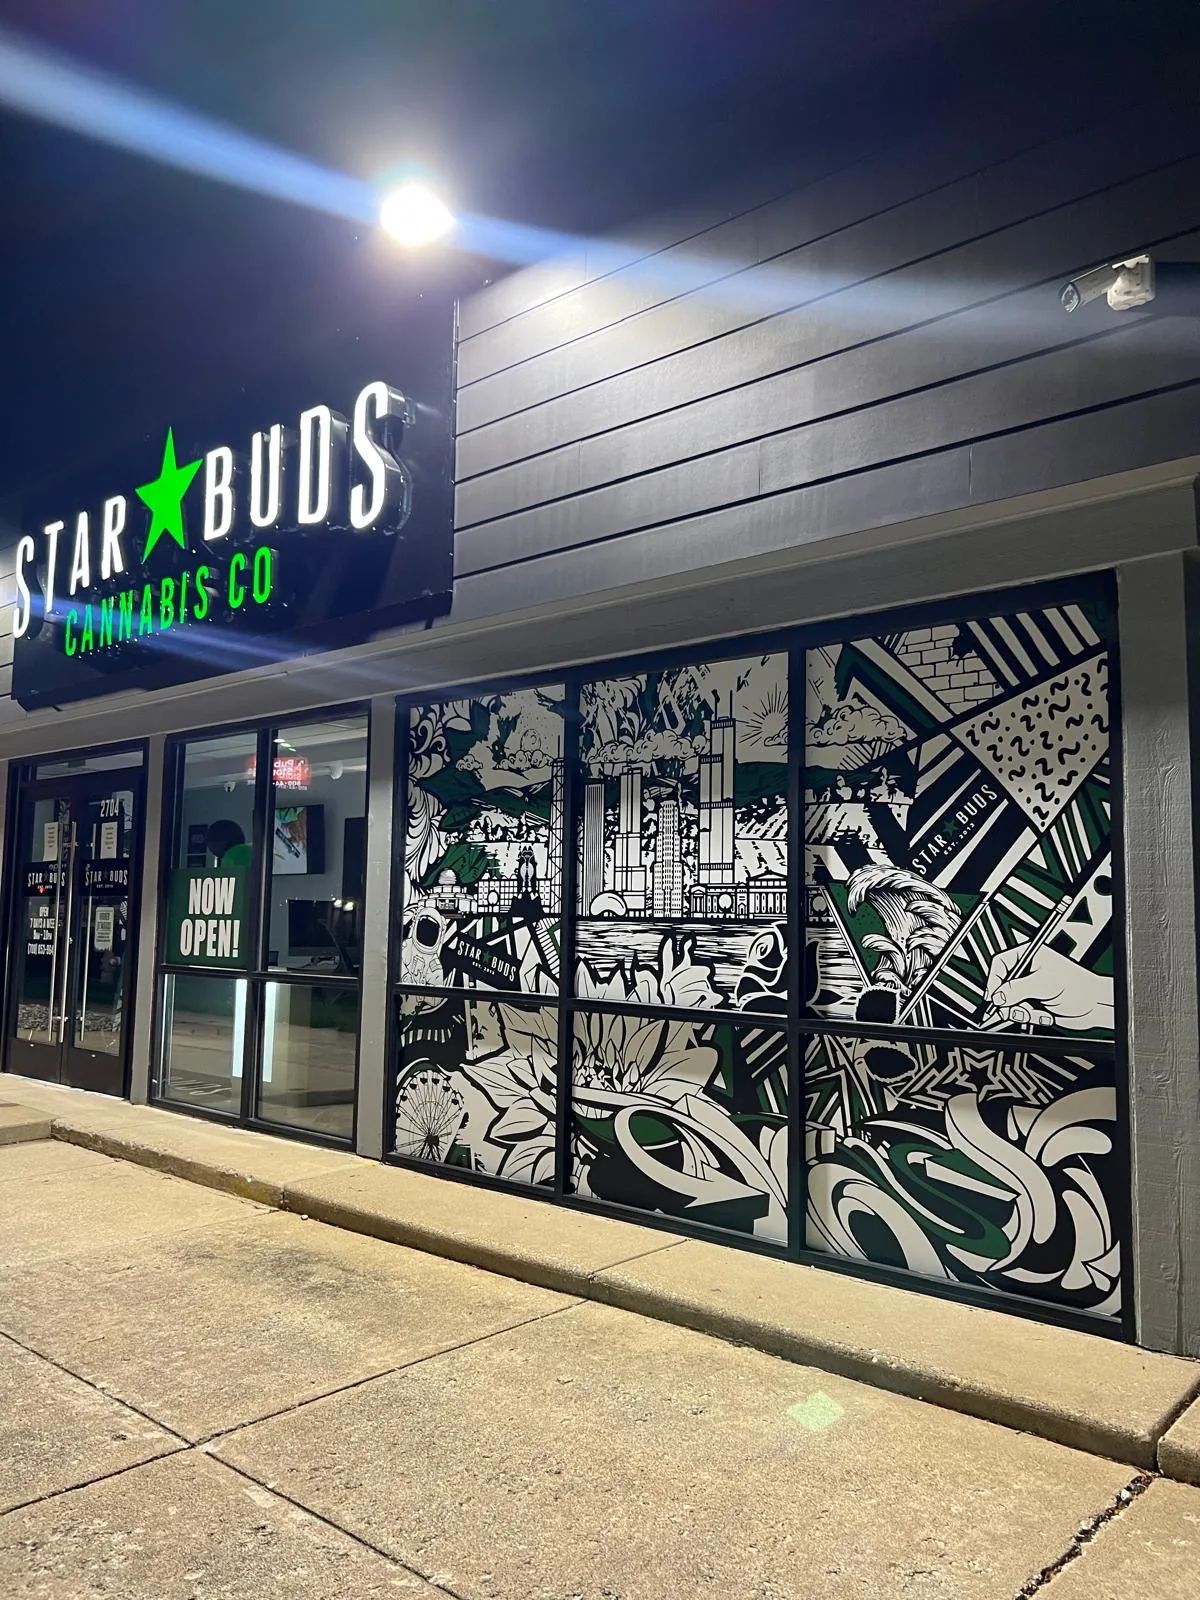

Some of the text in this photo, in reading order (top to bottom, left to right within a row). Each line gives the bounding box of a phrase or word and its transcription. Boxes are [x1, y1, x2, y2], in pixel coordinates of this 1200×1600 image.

[13, 381, 389, 638] STAR BUDS
[65, 546, 273, 656] CANNABIS CO
[100, 799, 119, 817] 2704
[912, 784, 998, 875] STAR BUDS
[943, 822, 975, 855] EST. 2013
[27, 871, 66, 887] STAR BUS
[85, 869, 128, 887] STAR BUDS
[188, 877, 236, 915] NOW
[46, 918, 56, 928] WEE
[180, 919, 241, 958] OPEN!
[457, 940, 517, 982] STAR BUDS
